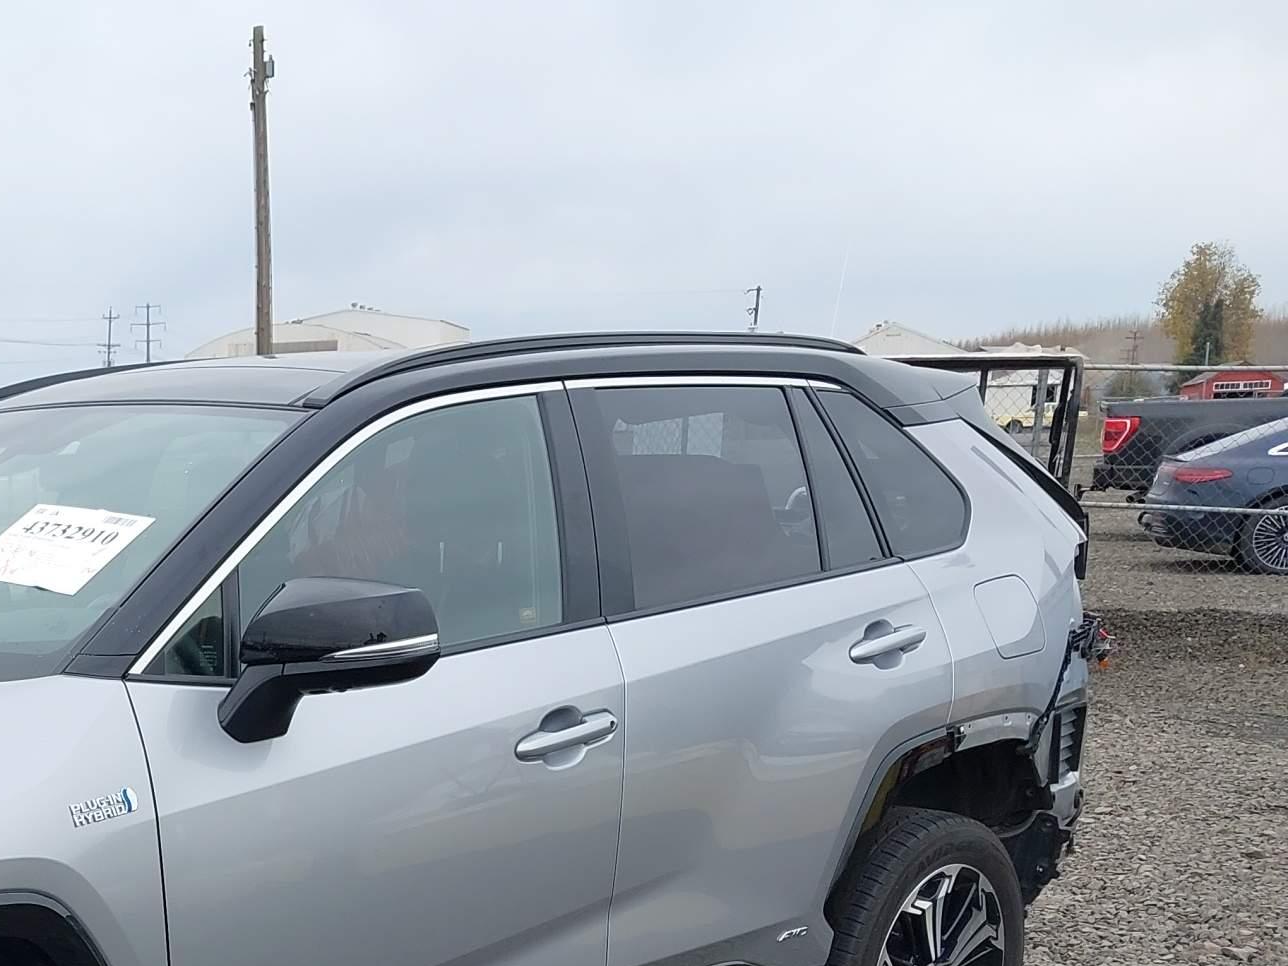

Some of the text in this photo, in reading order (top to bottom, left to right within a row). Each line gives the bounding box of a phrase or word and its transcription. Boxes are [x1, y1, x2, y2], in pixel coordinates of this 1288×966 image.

[22, 520, 120, 545] 43732910
[67, 792, 123, 815] PLUG-IN
[72, 804, 128, 828] HYBRID
